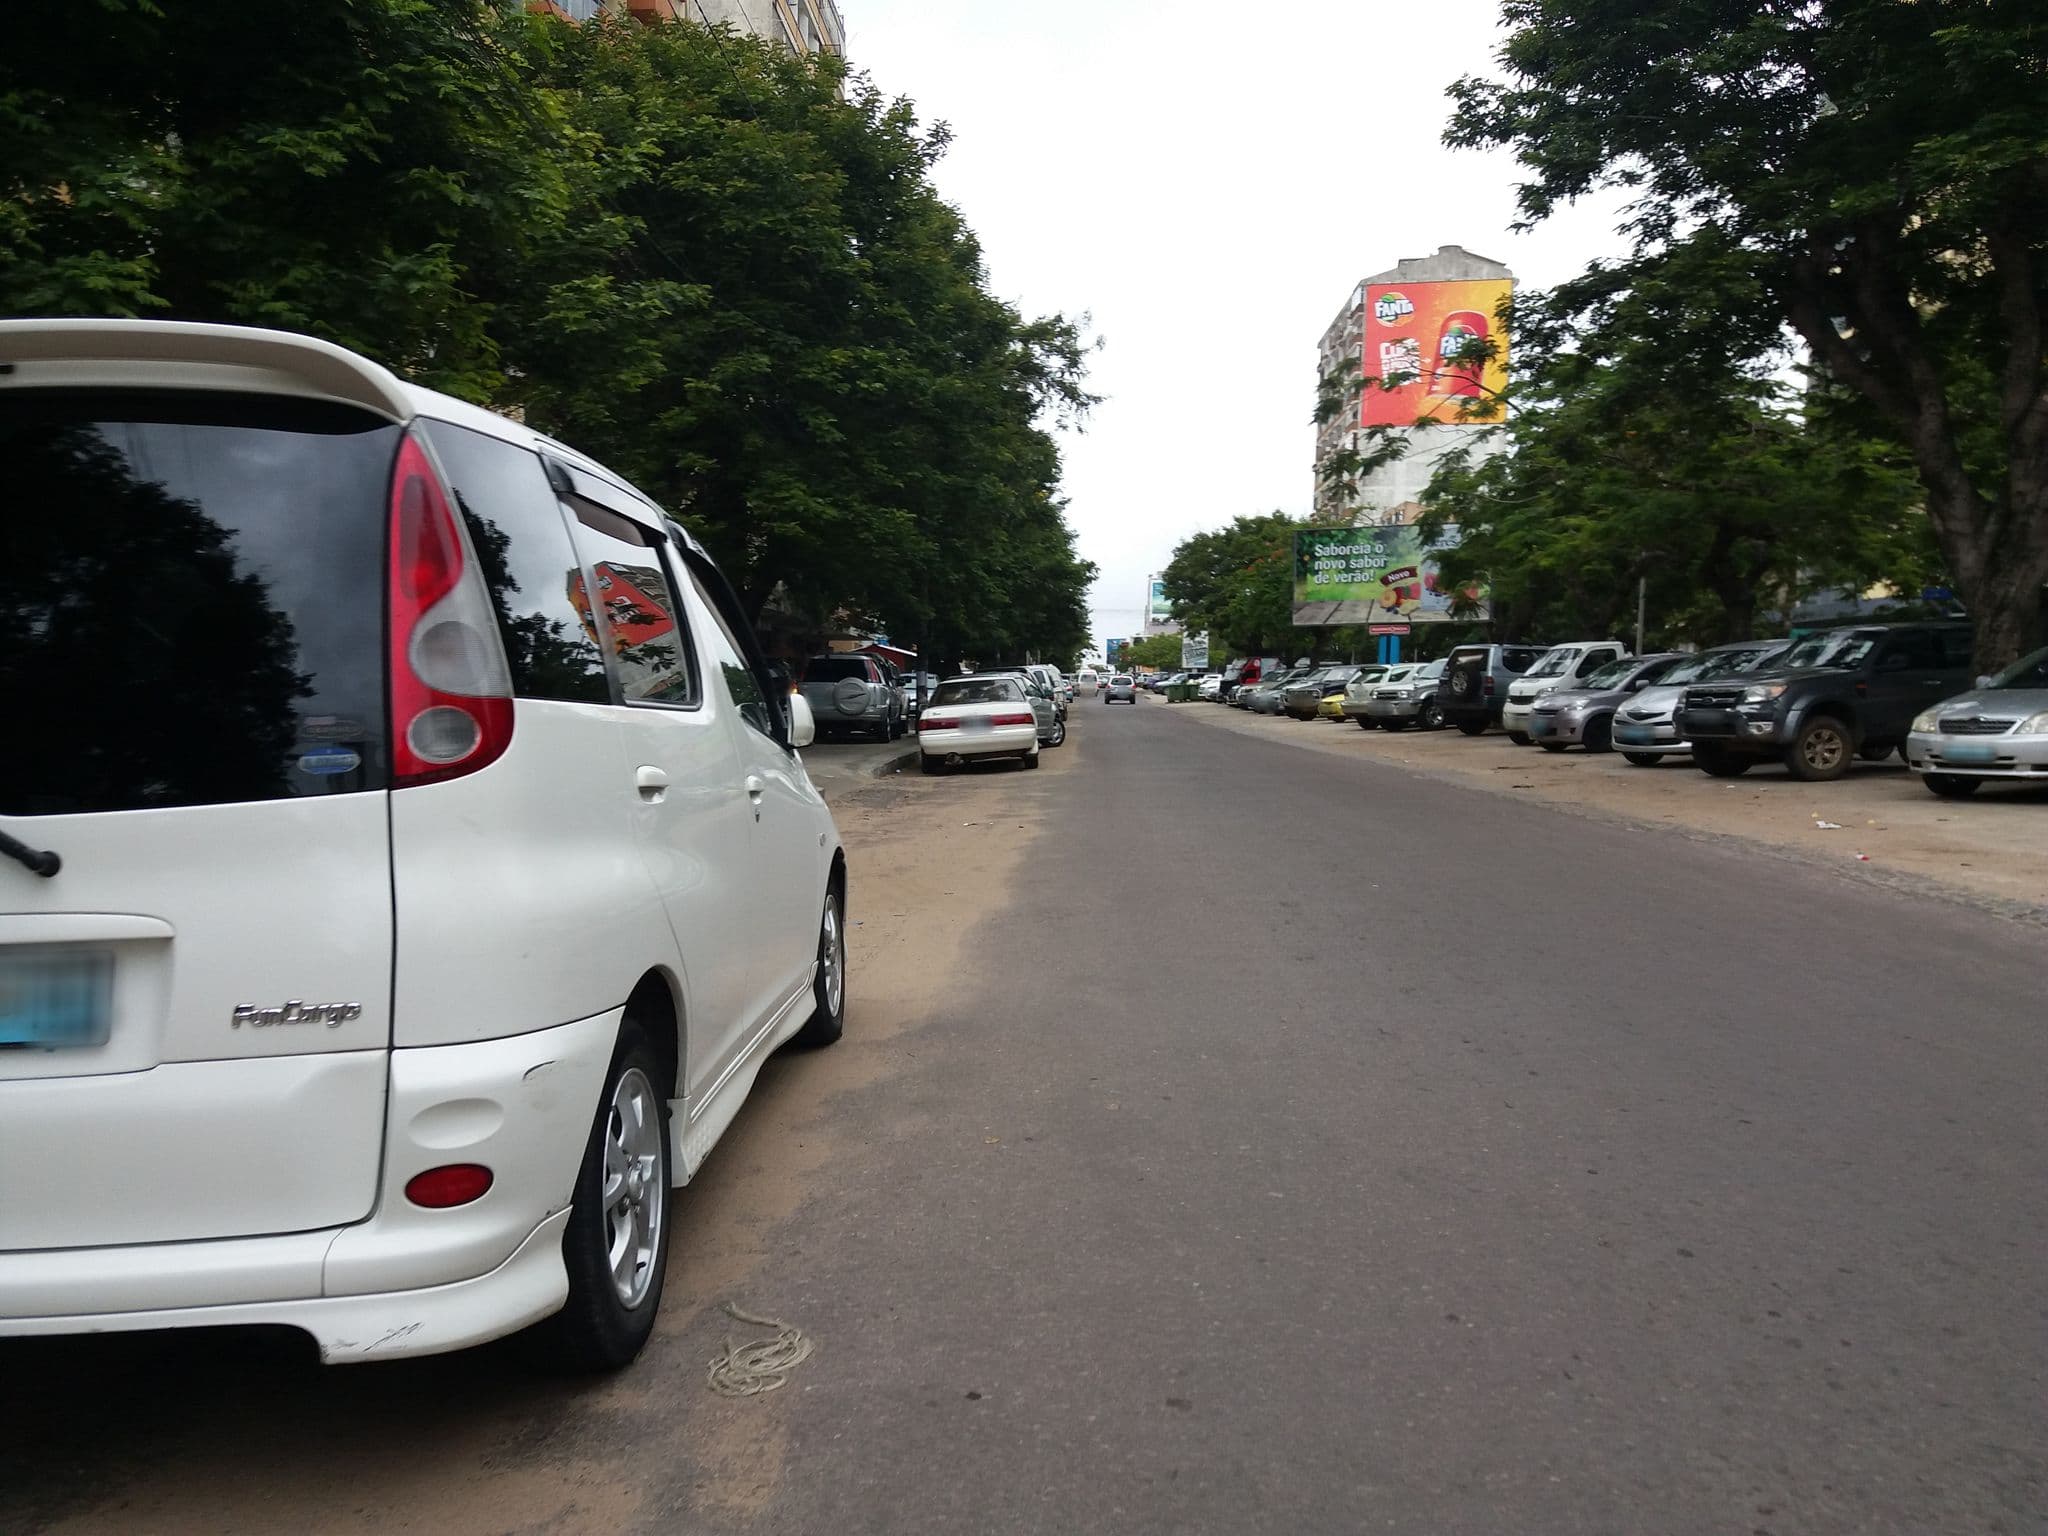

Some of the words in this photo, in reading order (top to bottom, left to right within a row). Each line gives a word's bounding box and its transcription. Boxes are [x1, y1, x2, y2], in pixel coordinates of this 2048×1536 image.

[1374, 299, 1414, 317] FANTA
[1314, 543, 1371, 557] Saboreia
[1314, 559, 1346, 570] novo
[1349, 556, 1387, 568] sabor
[1314, 572, 1329, 584] de
[1334, 570, 1374, 583] verão!
[1388, 571, 1410, 583] Novo
[231, 999, 361, 1028] FunCargo
